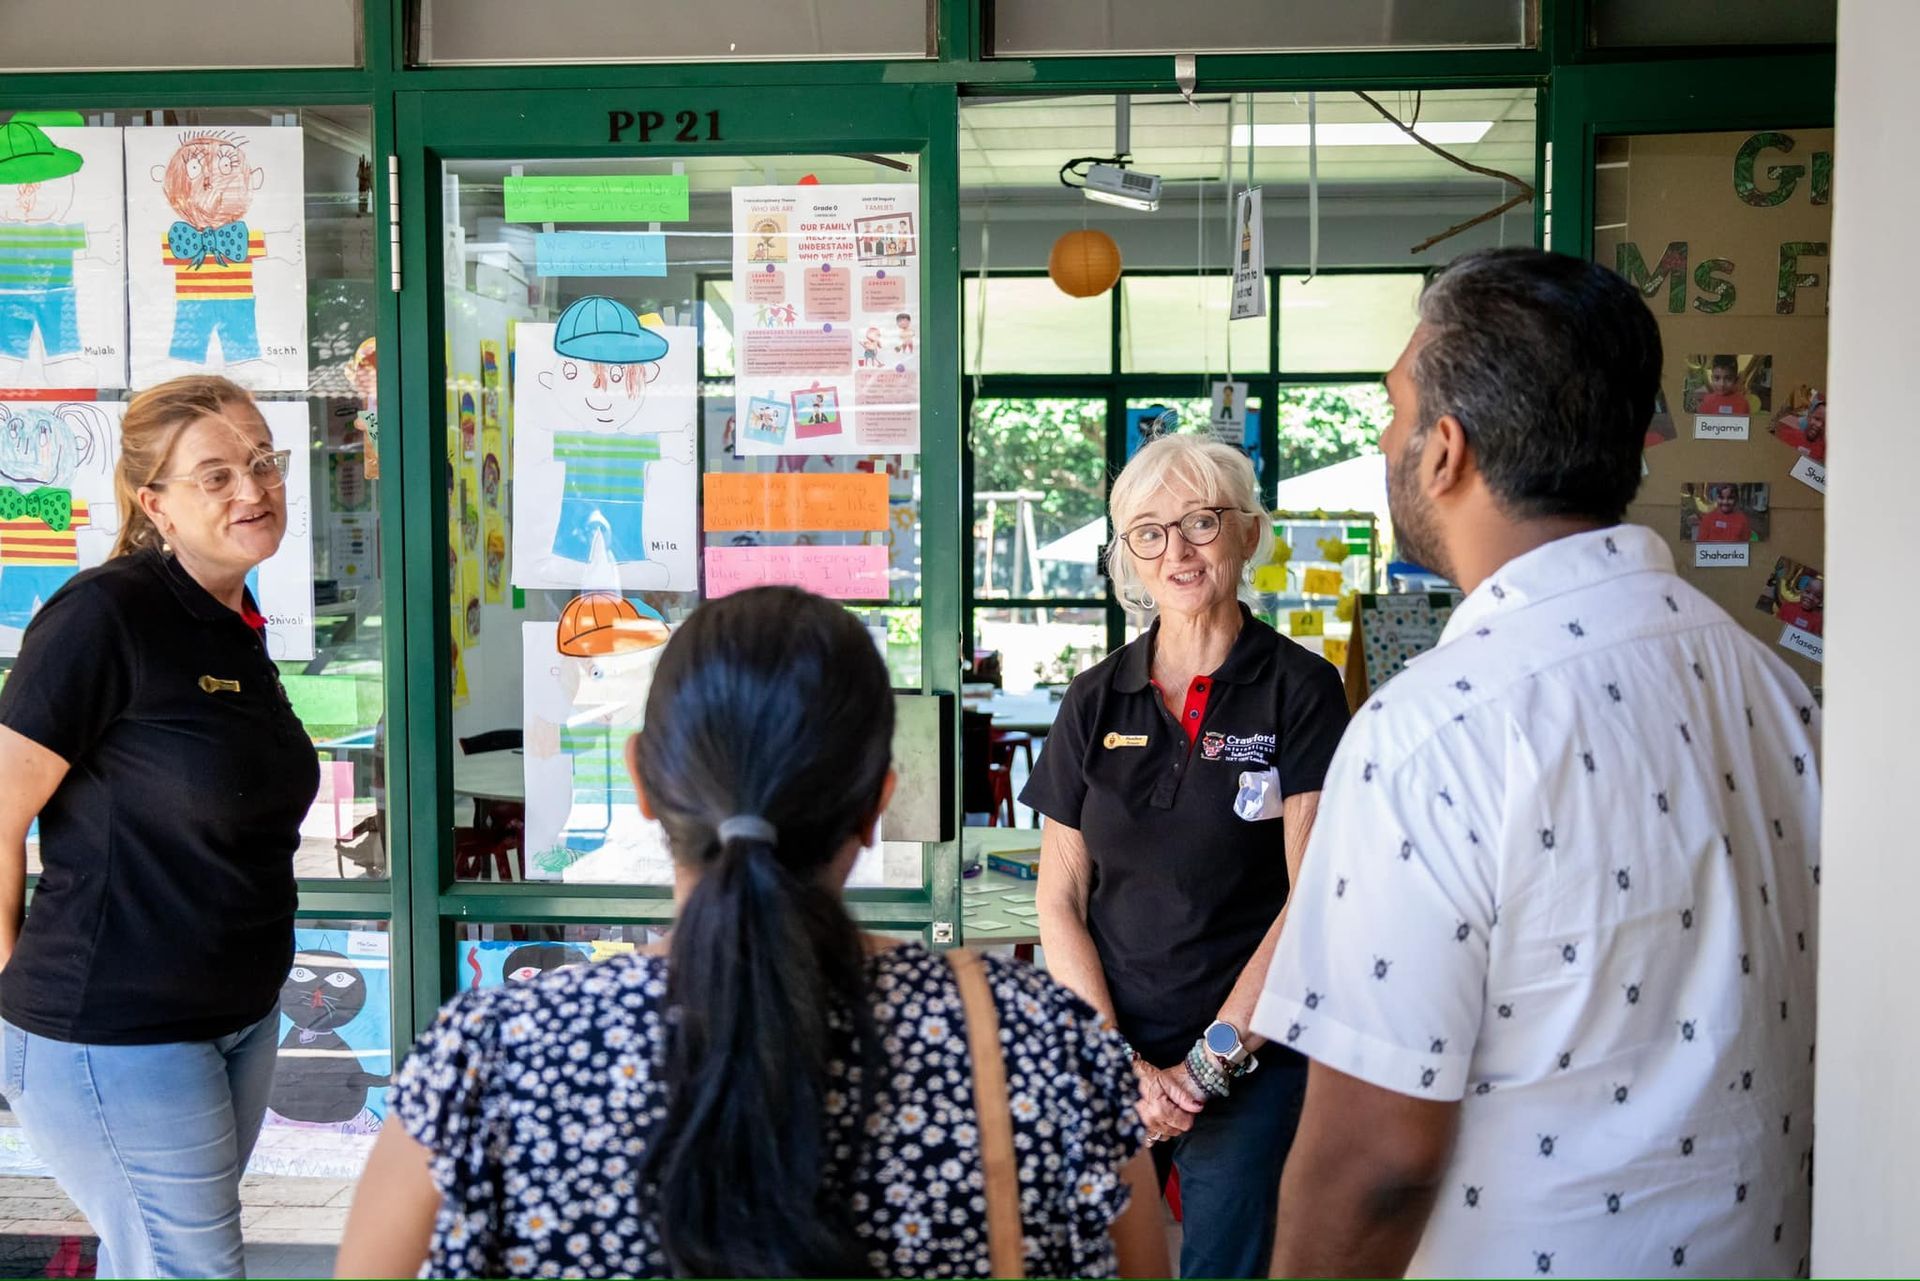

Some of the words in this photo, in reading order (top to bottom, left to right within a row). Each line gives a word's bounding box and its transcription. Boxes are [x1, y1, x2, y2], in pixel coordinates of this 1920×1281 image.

[608, 111, 664, 142] PP
[675, 110, 724, 141] 21
[544, 197, 575, 210] the
[591, 201, 671, 214] universe
[800, 223, 818, 231] OUR
[820, 222, 852, 231] FAMILY
[581, 239, 612, 250] are
[626, 238, 647, 251] all
[798, 242, 854, 251] UNDERSTAND
[1616, 241, 1736, 314] Ms
[1776, 241, 1831, 314] F
[1701, 421, 1744, 435] Benjamin
[847, 497, 878, 512] like
[711, 514, 766, 526] vanilla
[651, 541, 678, 551] Mila
[803, 554, 867, 566] wearing
[1699, 549, 1745, 560] Shaharika
[711, 567, 741, 579] blue
[822, 566, 833, 579] I
[269, 613, 304, 625] Shivali
[1226, 733, 1276, 745] Crawford
